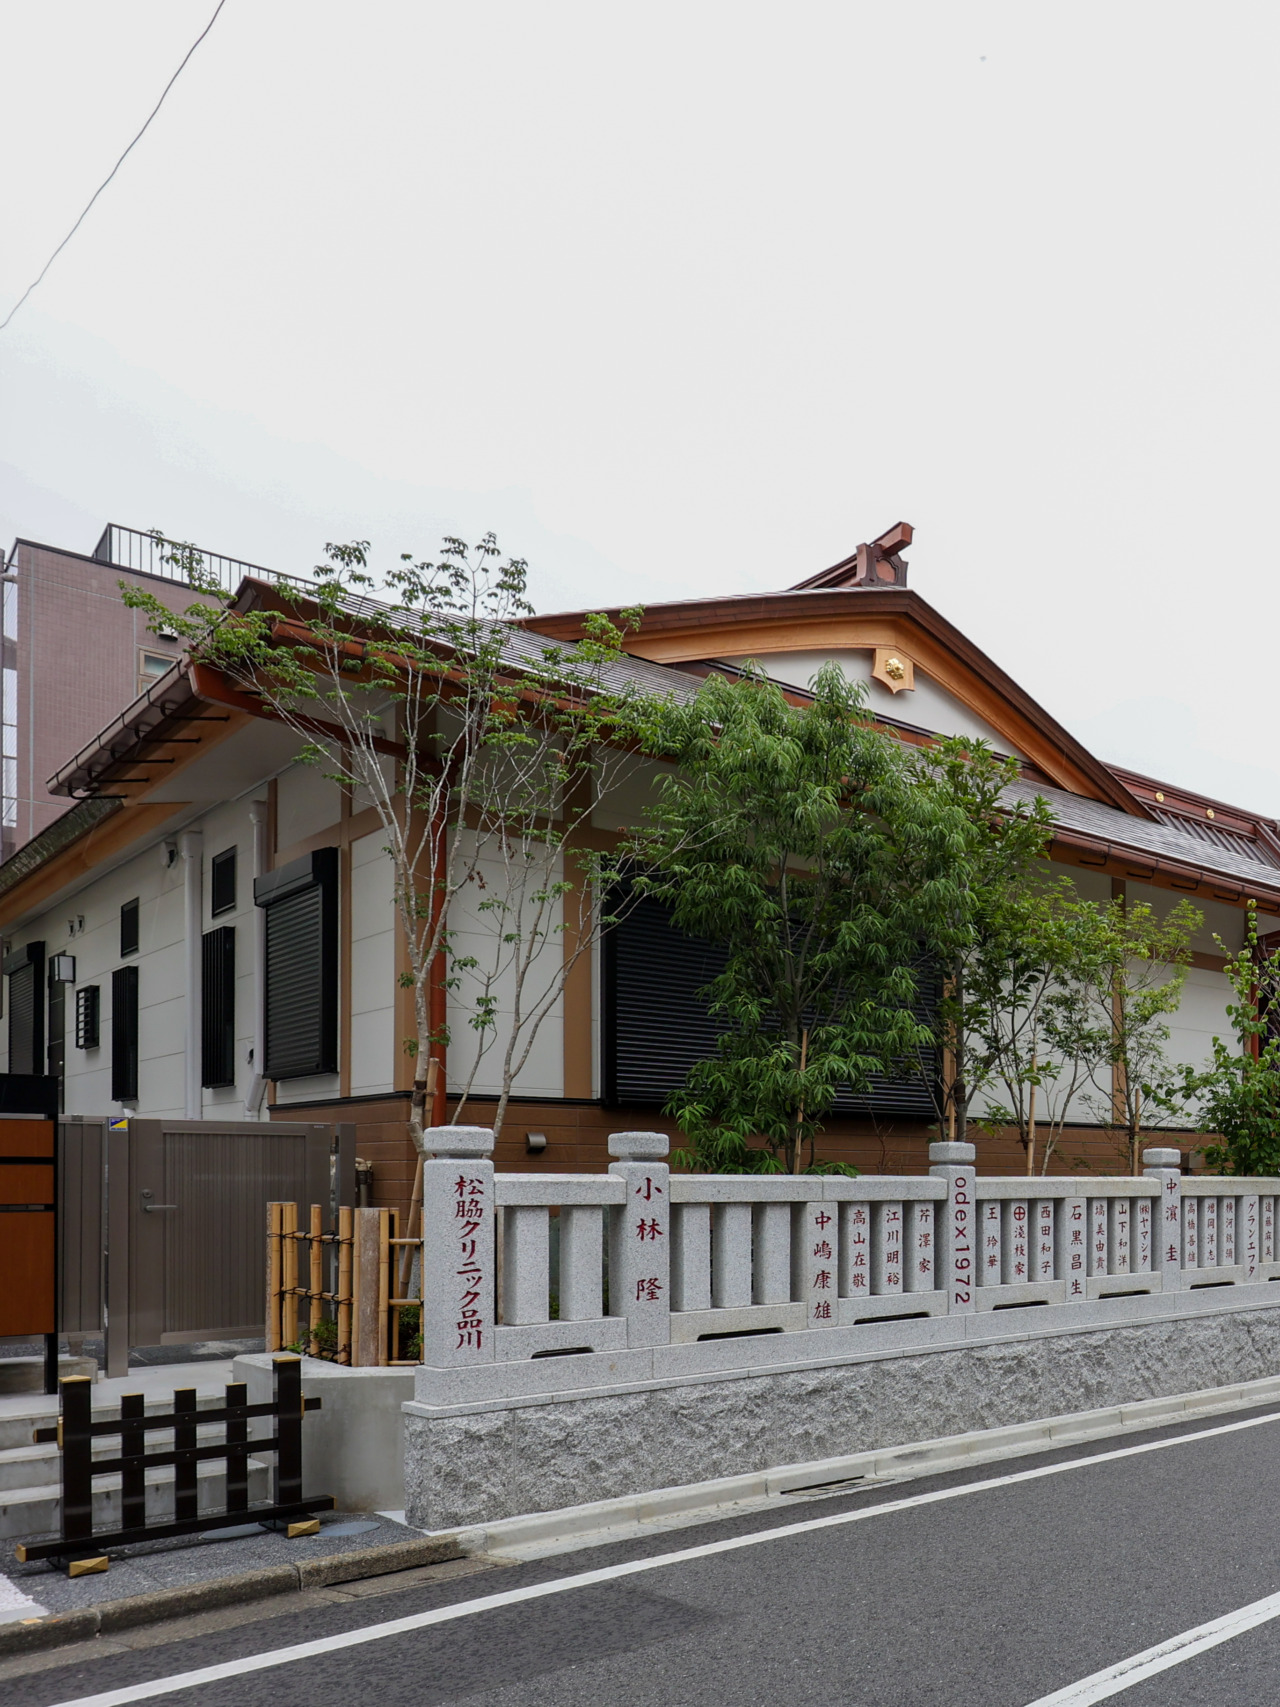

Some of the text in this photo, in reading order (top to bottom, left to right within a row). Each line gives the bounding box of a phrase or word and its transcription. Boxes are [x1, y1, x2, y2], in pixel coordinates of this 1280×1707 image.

[454, 1175, 484, 1351] 松脇クリニック品川
[813, 1210, 833, 1319] 中嶋康雄
[853, 1209, 866, 1288] 高山在敬
[886, 1209, 900, 1286] 江川明裕
[954, 1177, 971, 1304] odex1972
[1041, 1206, 1051, 1274] 西田和子
[1117, 1203, 1128, 1266] 山下和洋
[1247, 1201, 1257, 1278] グランエフタ
[1264, 1201, 1273, 1257] 遠藤麻美
